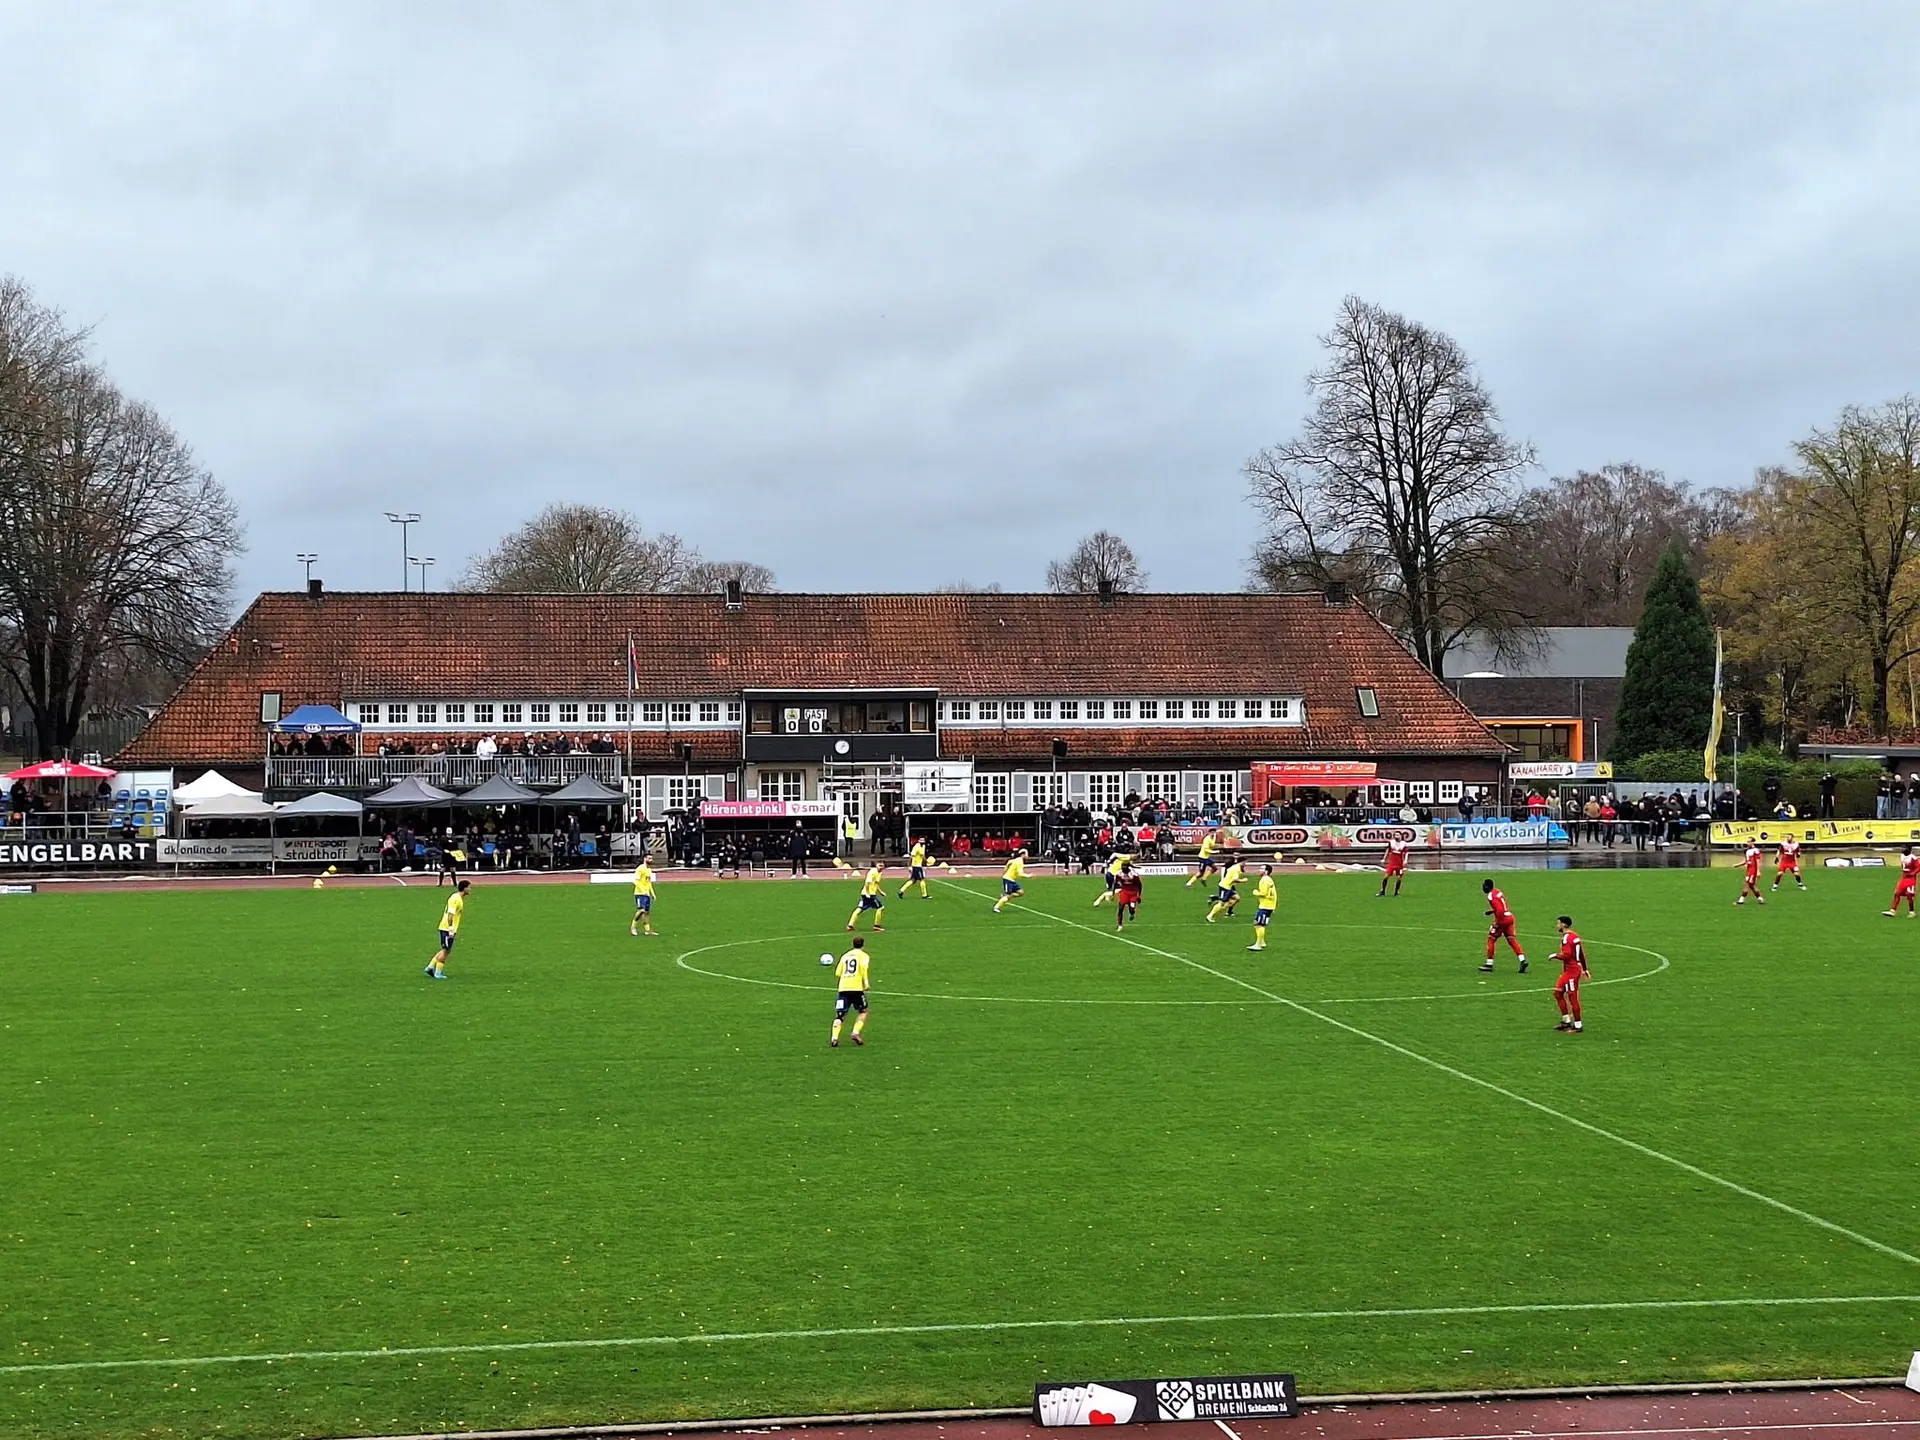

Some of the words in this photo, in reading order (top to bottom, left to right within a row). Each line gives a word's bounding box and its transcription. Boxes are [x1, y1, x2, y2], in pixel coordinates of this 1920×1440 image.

[704, 804, 737, 814] Hören
[1254, 830, 1301, 842] inkoop
[1363, 829, 1409, 841] inkop
[1471, 825, 1545, 839] Volksbank
[293, 840, 347, 848] INTERSPORT
[0, 842, 150, 863] ENGELBART
[845, 959, 857, 974] 19
[1195, 1381, 1286, 1401] SPIELBANK
[1197, 1402, 1243, 1416] BREMEN
